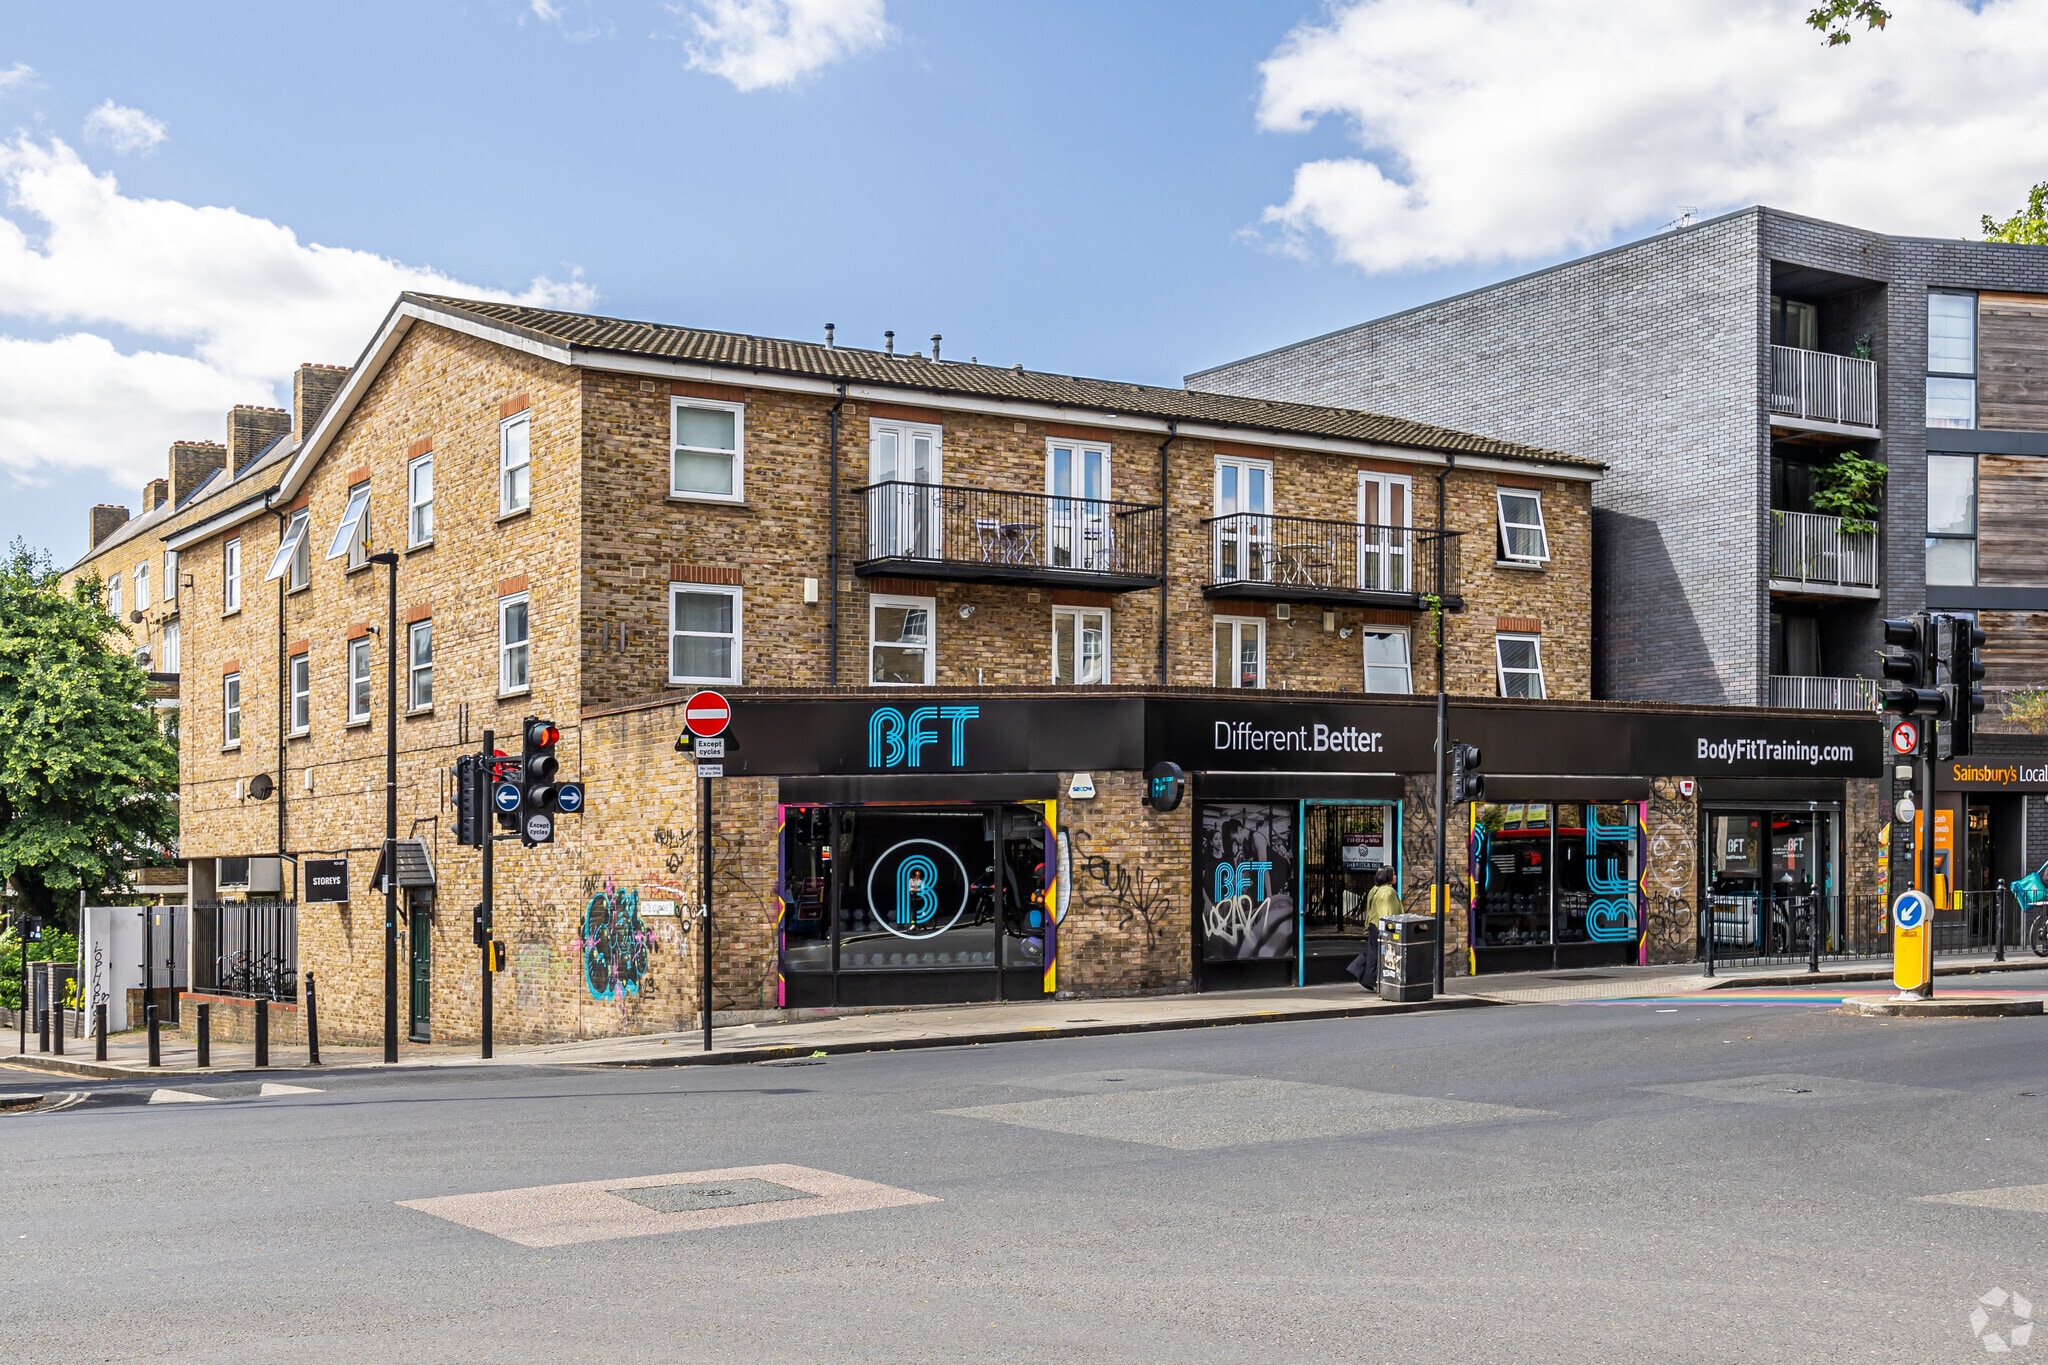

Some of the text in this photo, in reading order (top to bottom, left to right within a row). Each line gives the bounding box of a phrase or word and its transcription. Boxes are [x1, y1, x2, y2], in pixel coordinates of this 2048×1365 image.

[868, 706, 980, 768] BFT
[1697, 737, 1853, 766] BodyFitTraining.com
[1953, 764, 2048, 785] Sainsbury's Local
[1151, 776, 1174, 798] BFT
[1727, 838, 1745, 852] BFT
[1787, 837, 1804, 851] BFT
[312, 876, 341, 886] STOREYS
[1214, 861, 1273, 903] BFT
[1585, 804, 1638, 942] BFT
